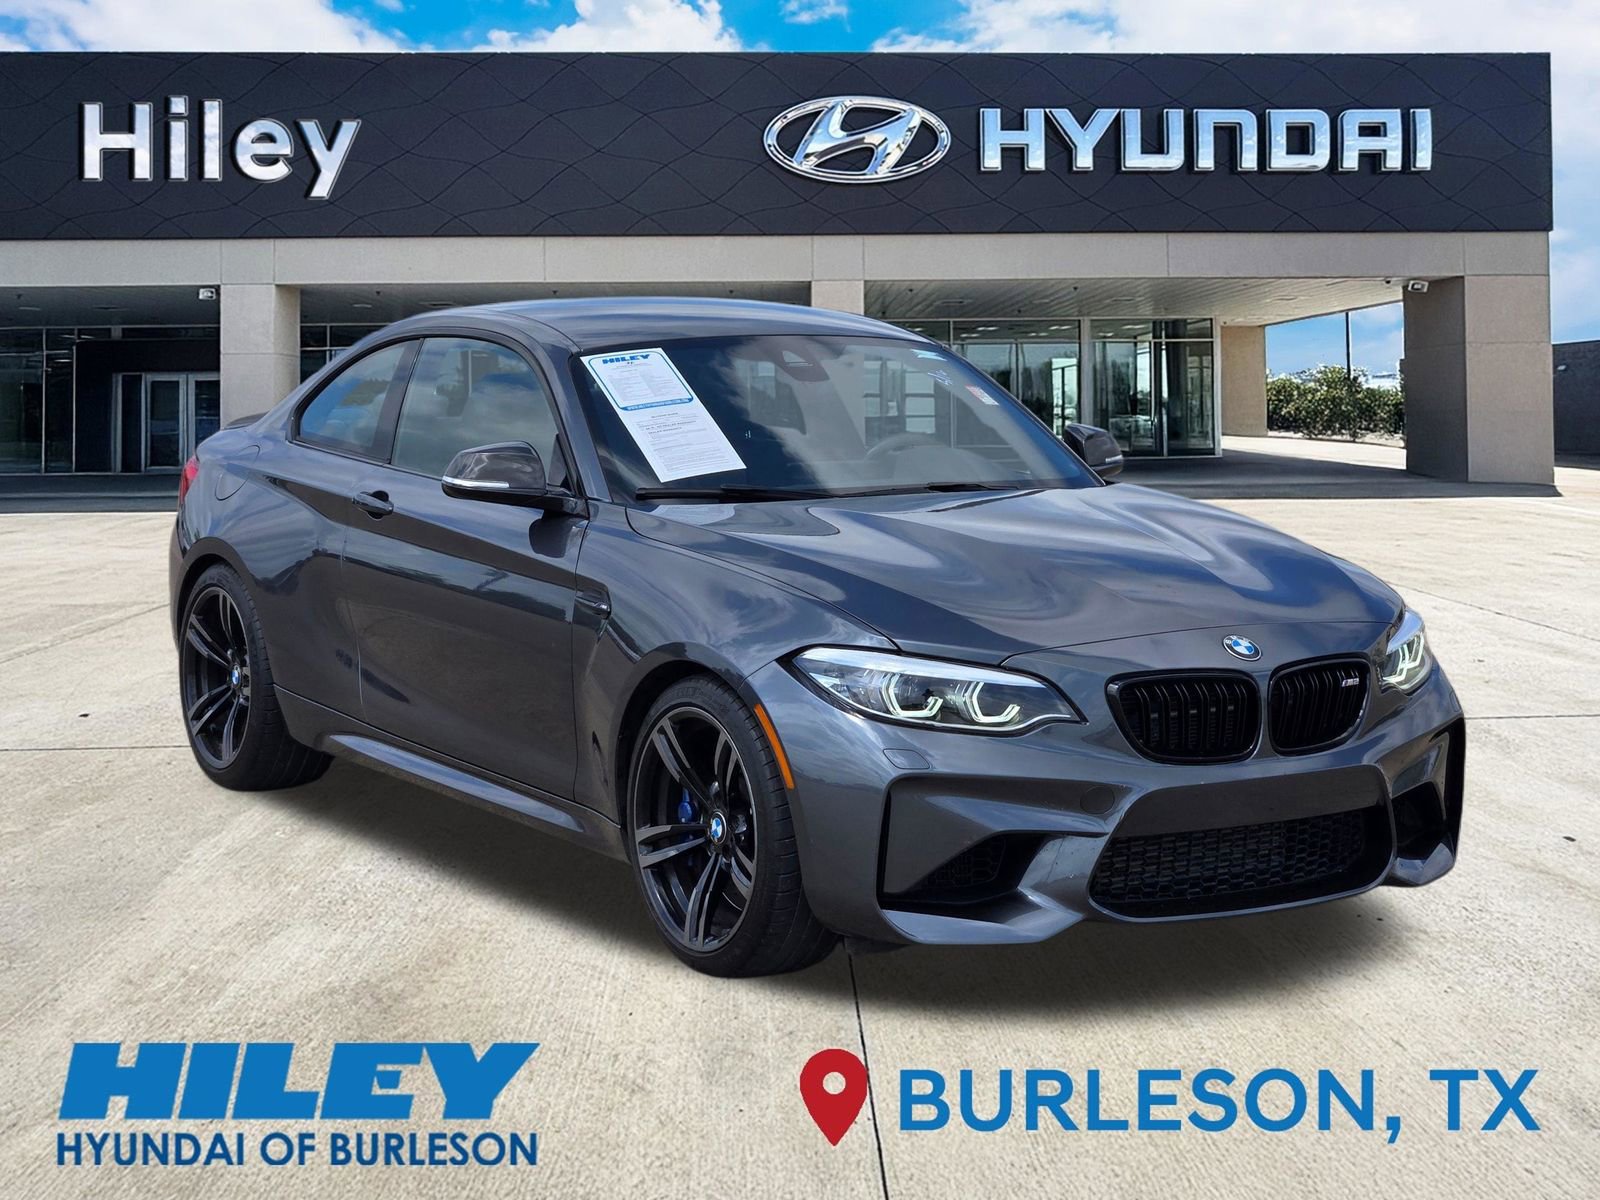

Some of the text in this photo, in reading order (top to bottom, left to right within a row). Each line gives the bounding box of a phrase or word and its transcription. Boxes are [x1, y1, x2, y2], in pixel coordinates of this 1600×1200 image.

[81, 95, 362, 201] Hiley
[979, 106, 1433, 172] HYUNDAI
[602, 353, 650, 364] HILEY
